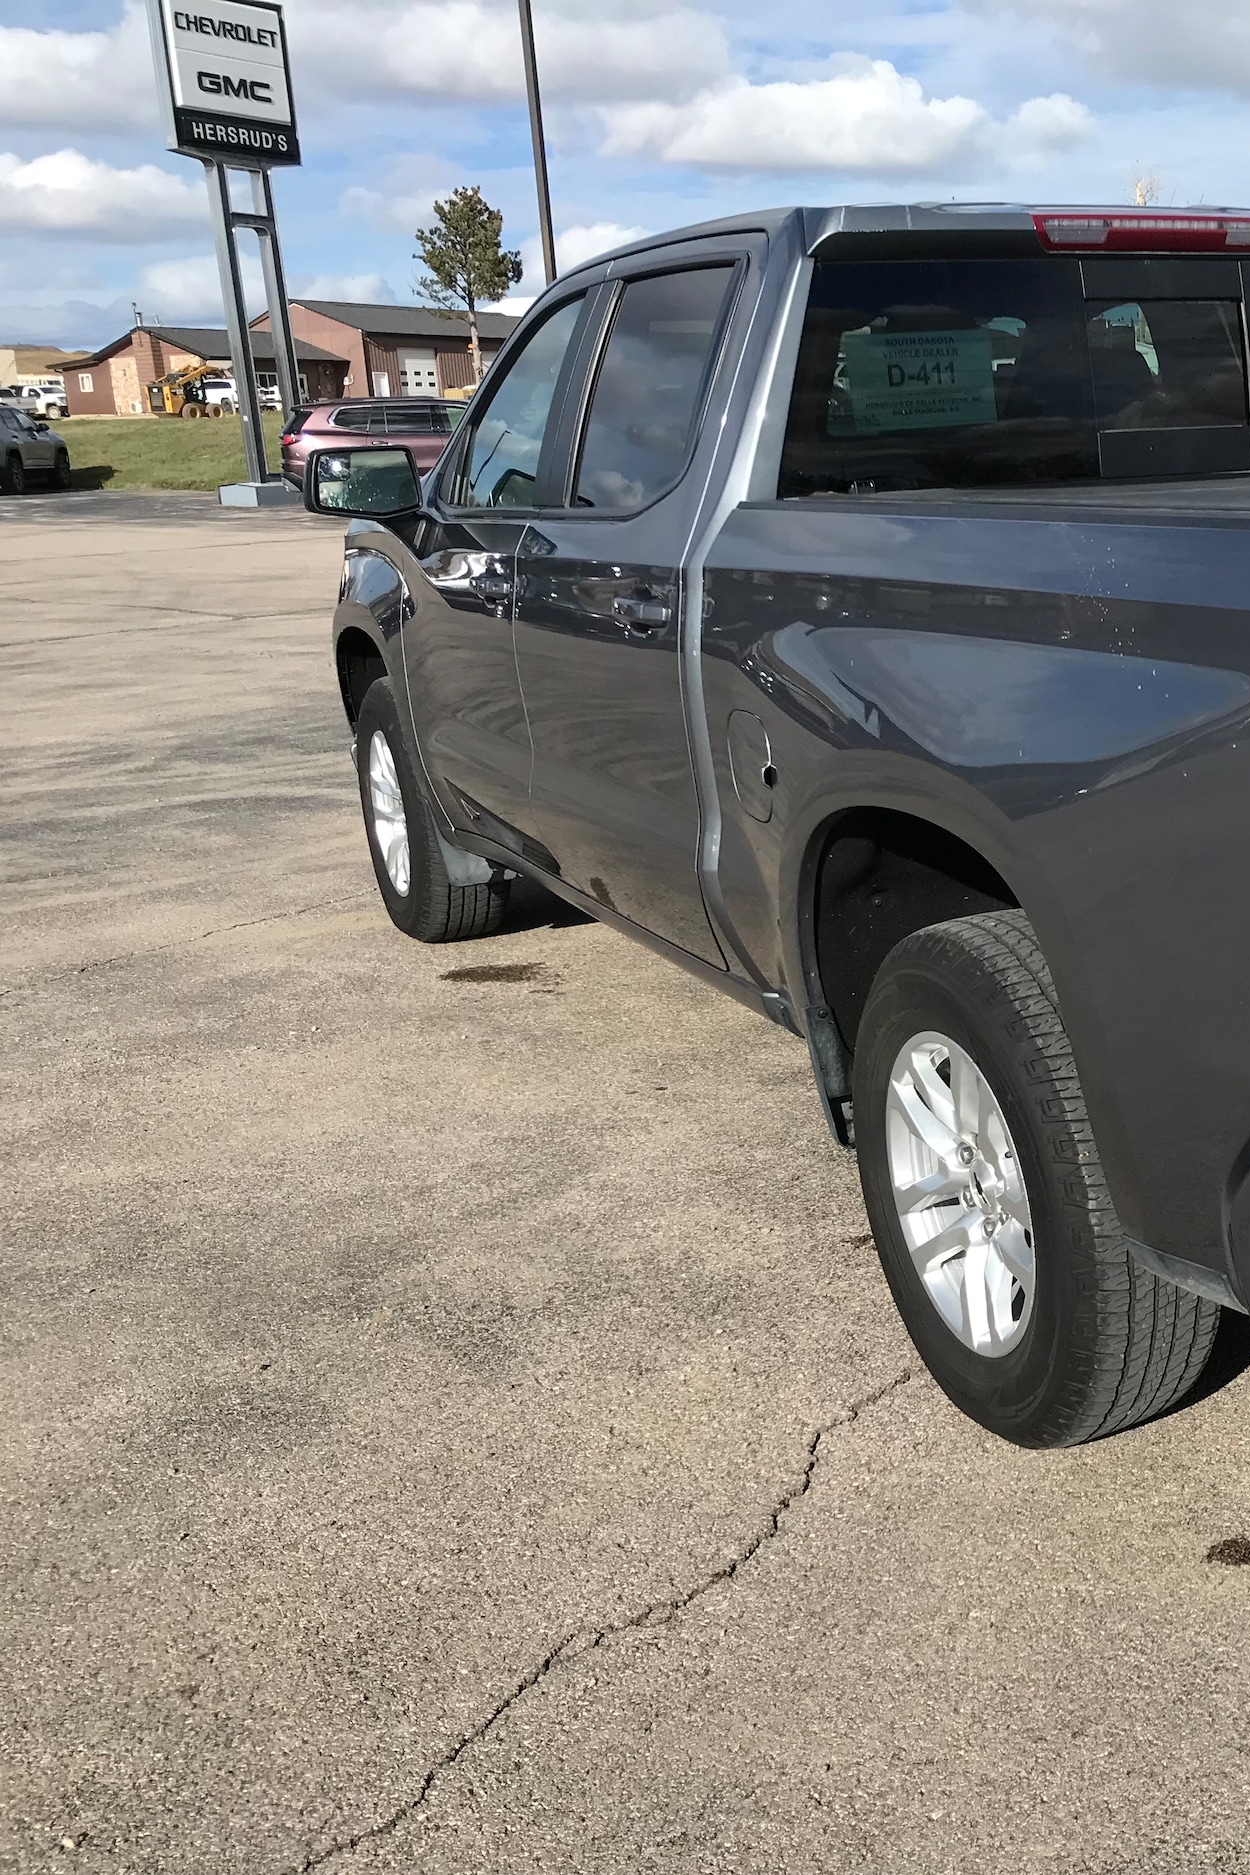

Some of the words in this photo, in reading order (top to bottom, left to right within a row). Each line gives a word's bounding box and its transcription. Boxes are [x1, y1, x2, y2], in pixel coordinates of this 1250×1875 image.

[174, 11, 278, 48] CHEVROLET
[197, 71, 272, 103] GMC
[192, 121, 288, 152] HERSRUD'S
[882, 349, 922, 359] VEHICLE
[922, 347, 959, 358] DEALER
[884, 337, 916, 347] SOUTH
[917, 335, 954, 346] DAKOTA
[887, 361, 957, 387] D-411
